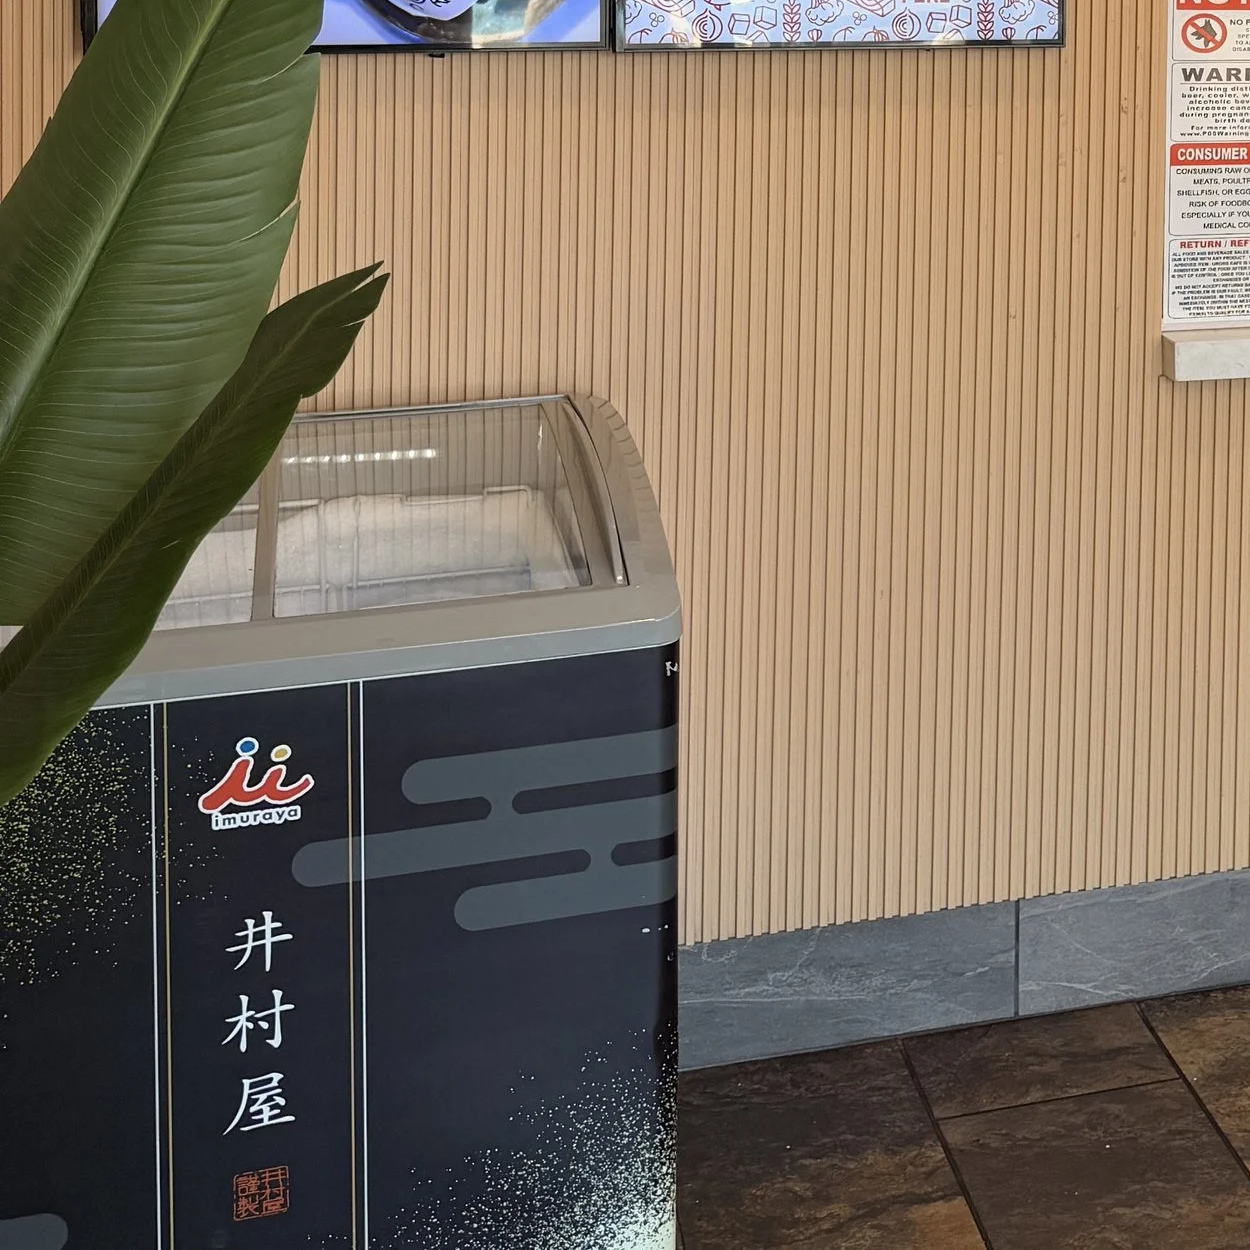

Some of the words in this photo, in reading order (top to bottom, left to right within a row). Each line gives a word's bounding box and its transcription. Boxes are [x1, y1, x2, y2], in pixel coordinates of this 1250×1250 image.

[1177, 147, 1248, 161] CONSUMER
[1180, 240, 1222, 248] RETURN
[211, 806, 301, 830] imuraya
[223, 909, 296, 1137] 井村屋
